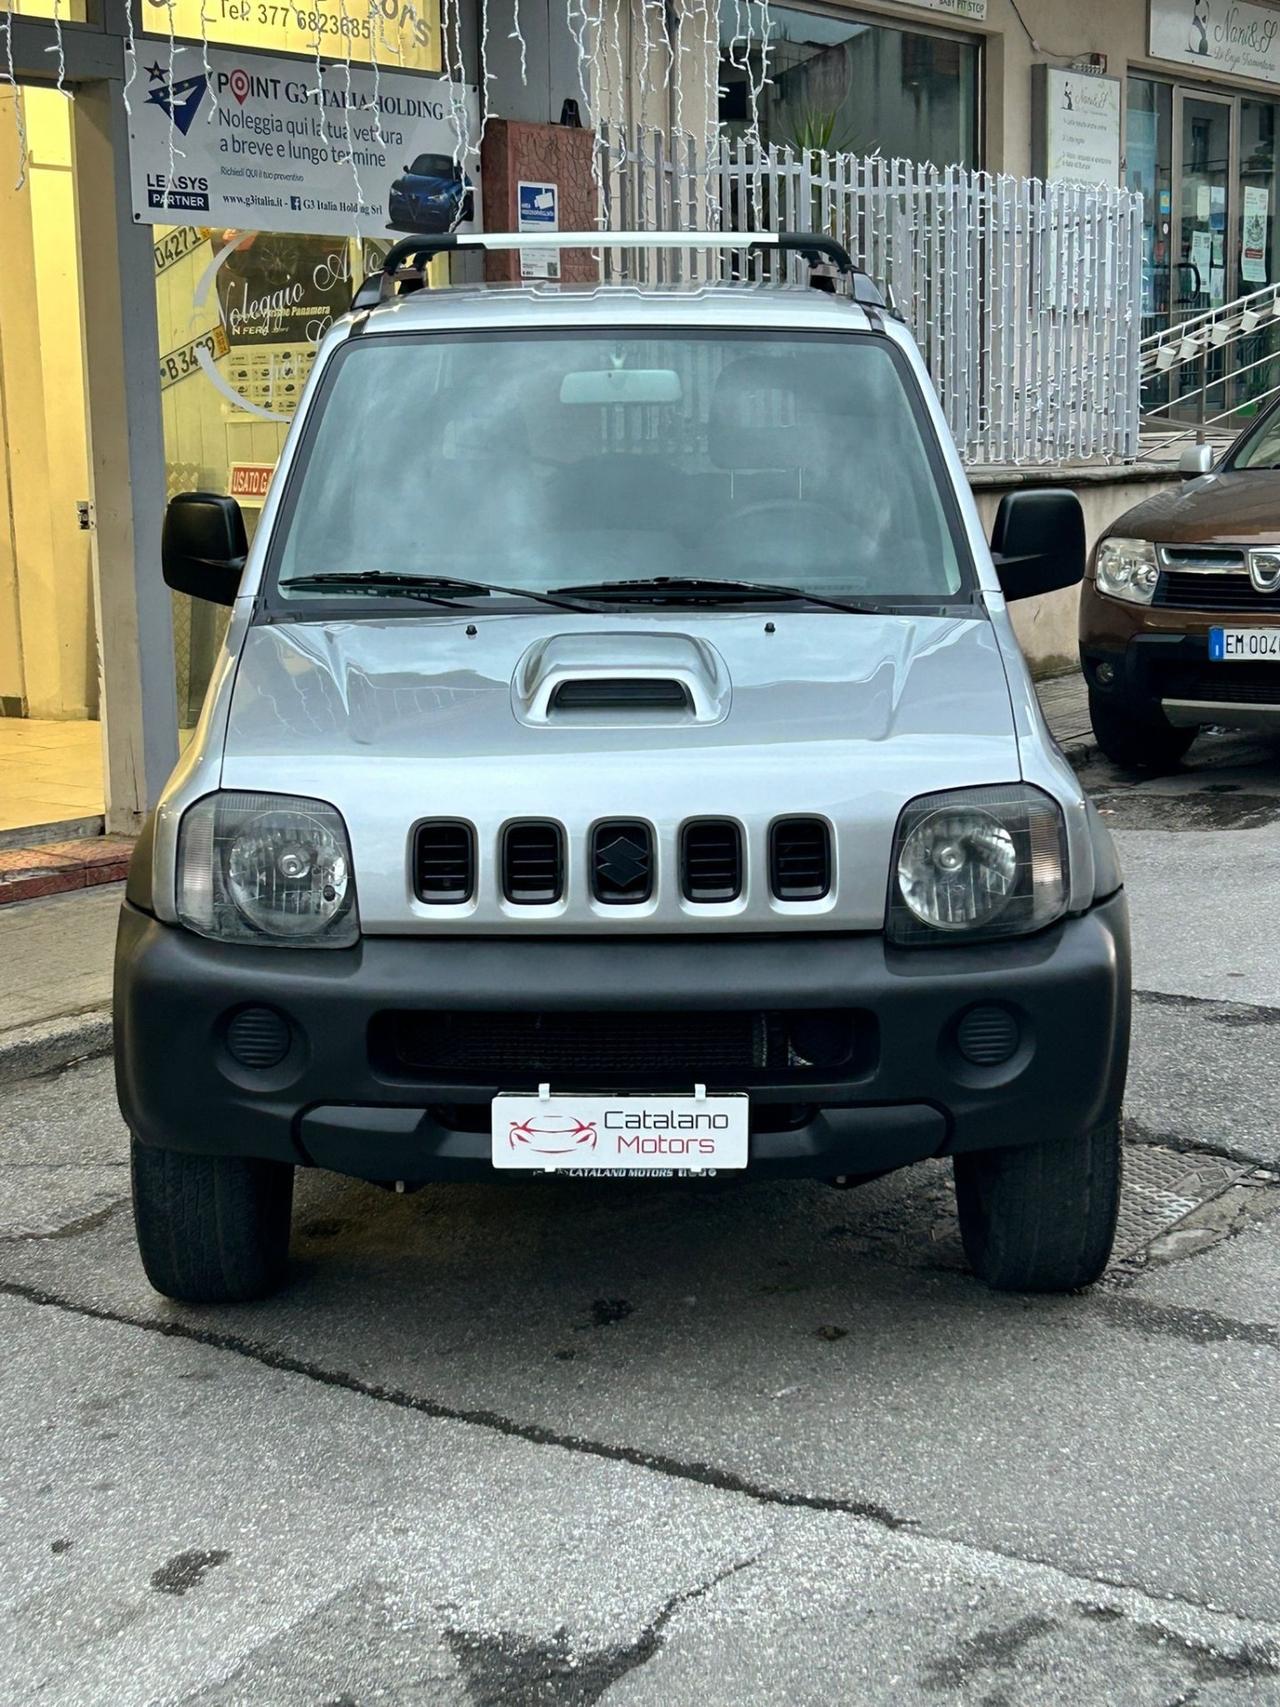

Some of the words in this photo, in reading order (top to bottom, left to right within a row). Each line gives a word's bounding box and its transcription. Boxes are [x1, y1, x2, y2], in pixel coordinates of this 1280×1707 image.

[258, 4, 289, 27] 377
[297, 10, 371, 39] 6823685
[285, 81, 308, 104] G3
[371, 94, 444, 120] HOLDING
[218, 107, 283, 136] Noleggia
[286, 116, 308, 138] qui
[220, 138, 229, 152] a
[231, 134, 274, 157] breve
[276, 143, 286, 157] e
[288, 140, 328, 165] lungo
[331, 145, 387, 167] termine
[146, 173, 209, 192] LEASYS
[220, 165, 245, 178] Richiedi
[152, 193, 205, 209] PARTNER
[222, 194, 283, 209] www.g3italia.it
[303, 199, 316, 210] G3
[340, 203, 370, 216] Holdng
[371, 204, 383, 216] Srl
[166, 336, 215, 381] B349
[232, 471, 259, 493] USATO
[1226, 634, 1244, 655] EM
[1249, 635, 1280, 655] 004
[604, 1109, 729, 1130] Catalano
[617, 1134, 716, 1154] Motors
